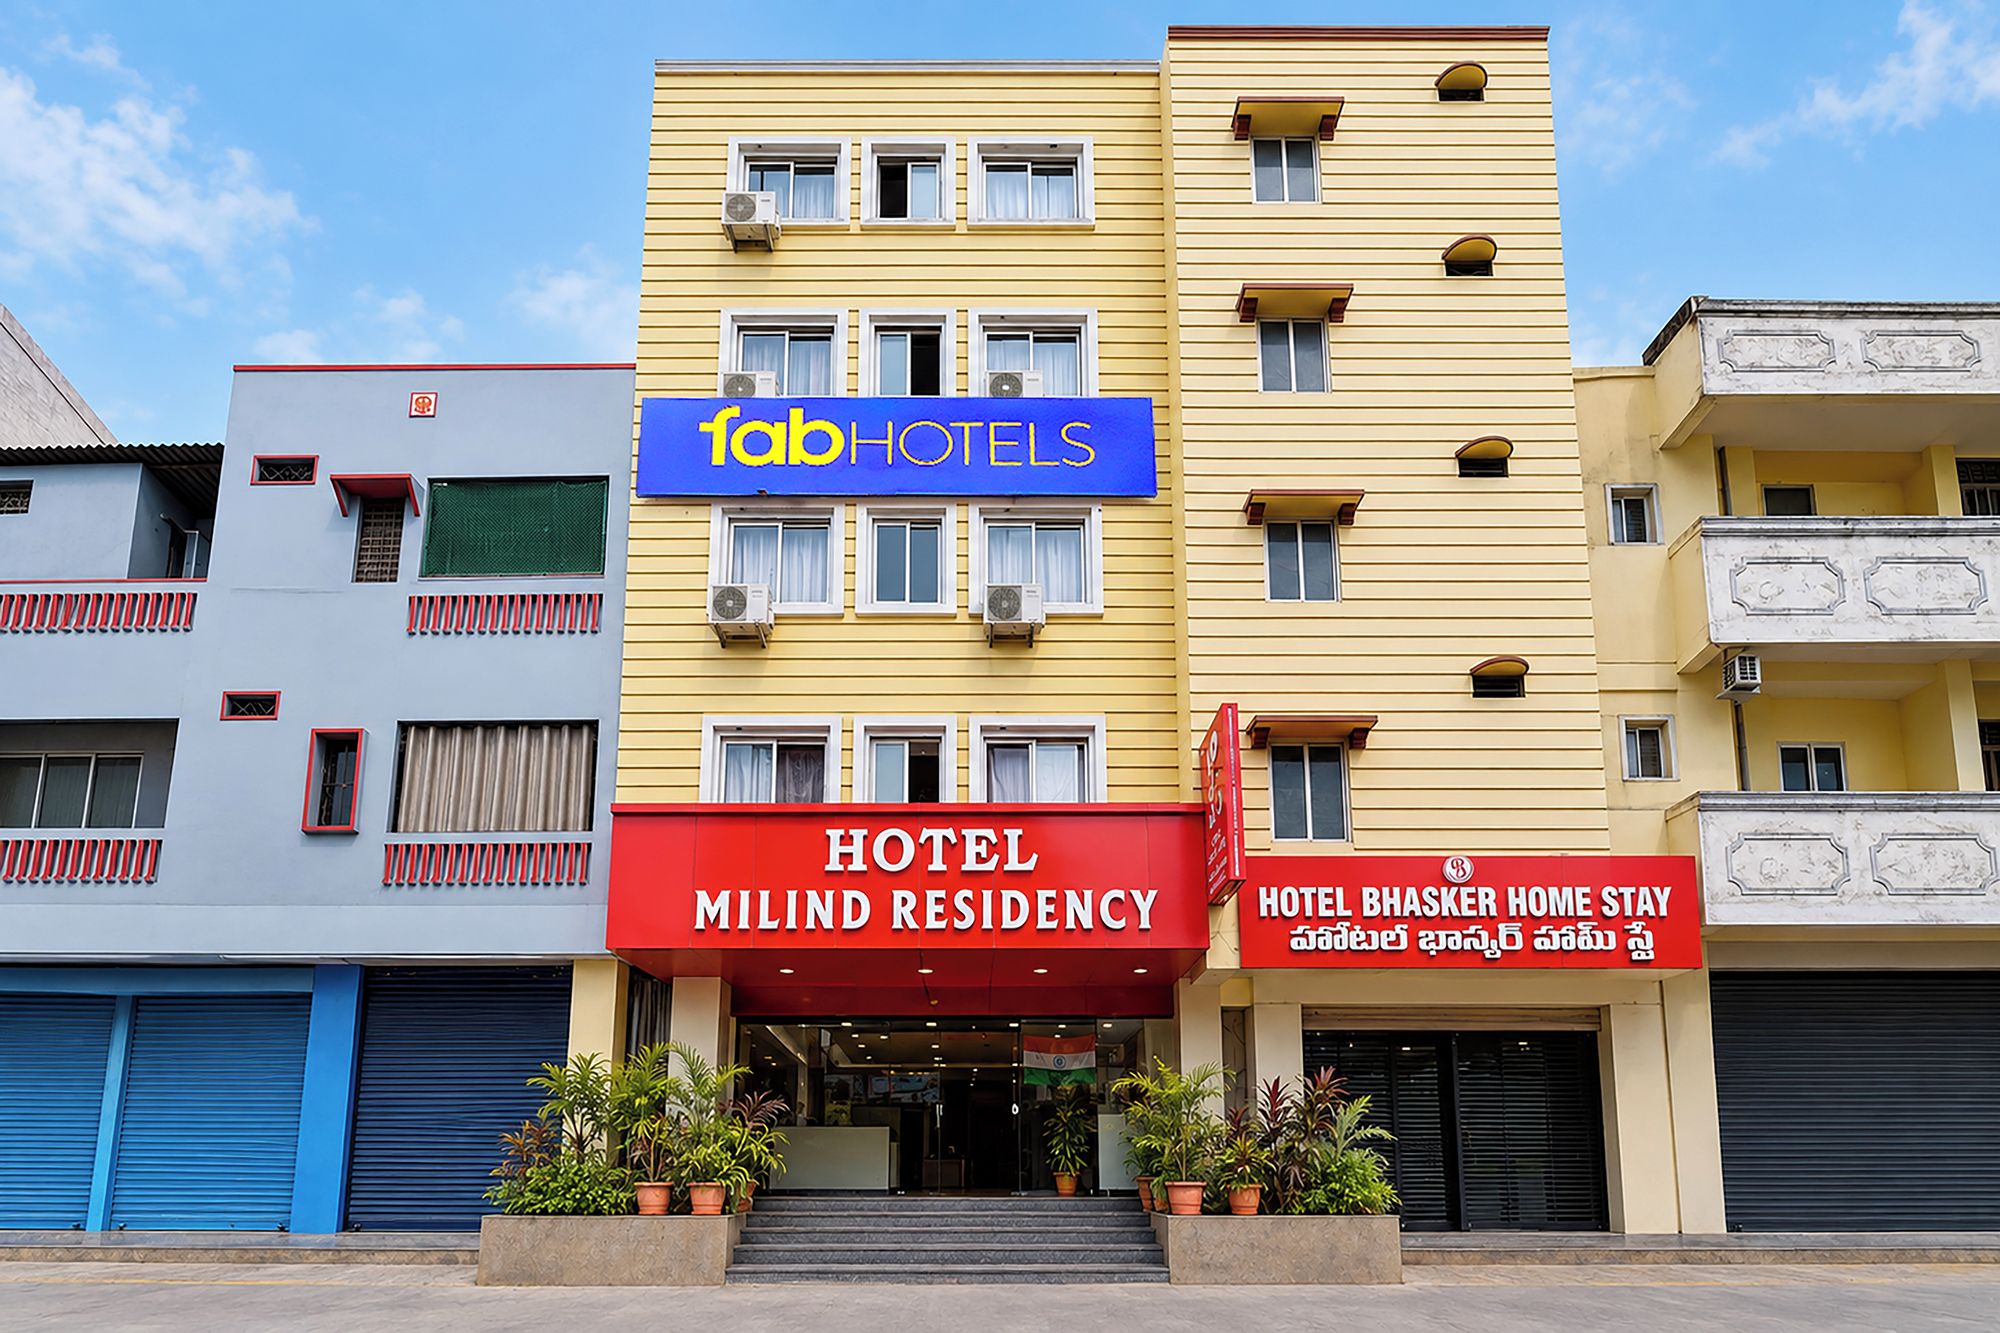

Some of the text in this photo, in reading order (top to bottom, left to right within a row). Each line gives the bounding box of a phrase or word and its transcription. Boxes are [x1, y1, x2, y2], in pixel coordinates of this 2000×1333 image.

[825, 828, 1039, 872] HOTEL
[694, 888, 1158, 930] MILIND RESIDENCY
[1258, 886, 1672, 917] HOTEL BHASKER HOME STAY
